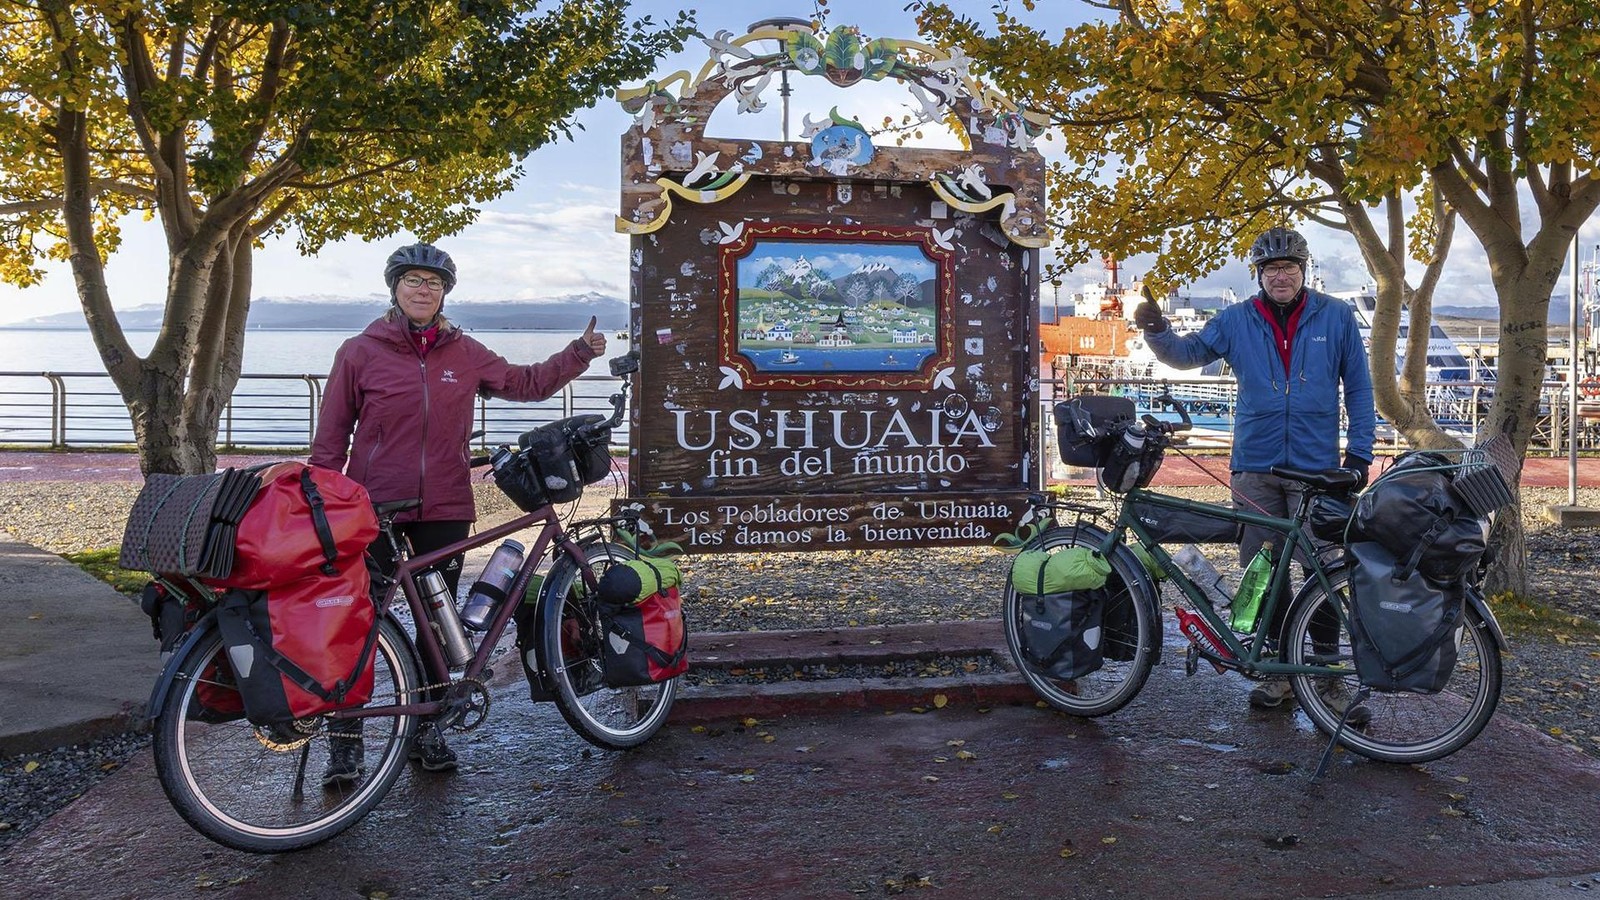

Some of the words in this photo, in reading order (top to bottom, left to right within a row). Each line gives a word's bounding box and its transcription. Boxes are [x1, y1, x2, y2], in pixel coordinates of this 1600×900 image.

[669, 408, 996, 451] USHUAIA
[705, 449, 759, 478] fin
[780, 449, 833, 476] del
[853, 449, 965, 476] mundo
[659, 508, 710, 526] Los
[717, 504, 855, 525] Pobladores
[872, 505, 905, 521] de
[913, 501, 1013, 521] Ushuaia
[683, 528, 726, 546] les
[734, 525, 813, 545] damos
[825, 526, 851, 542] la
